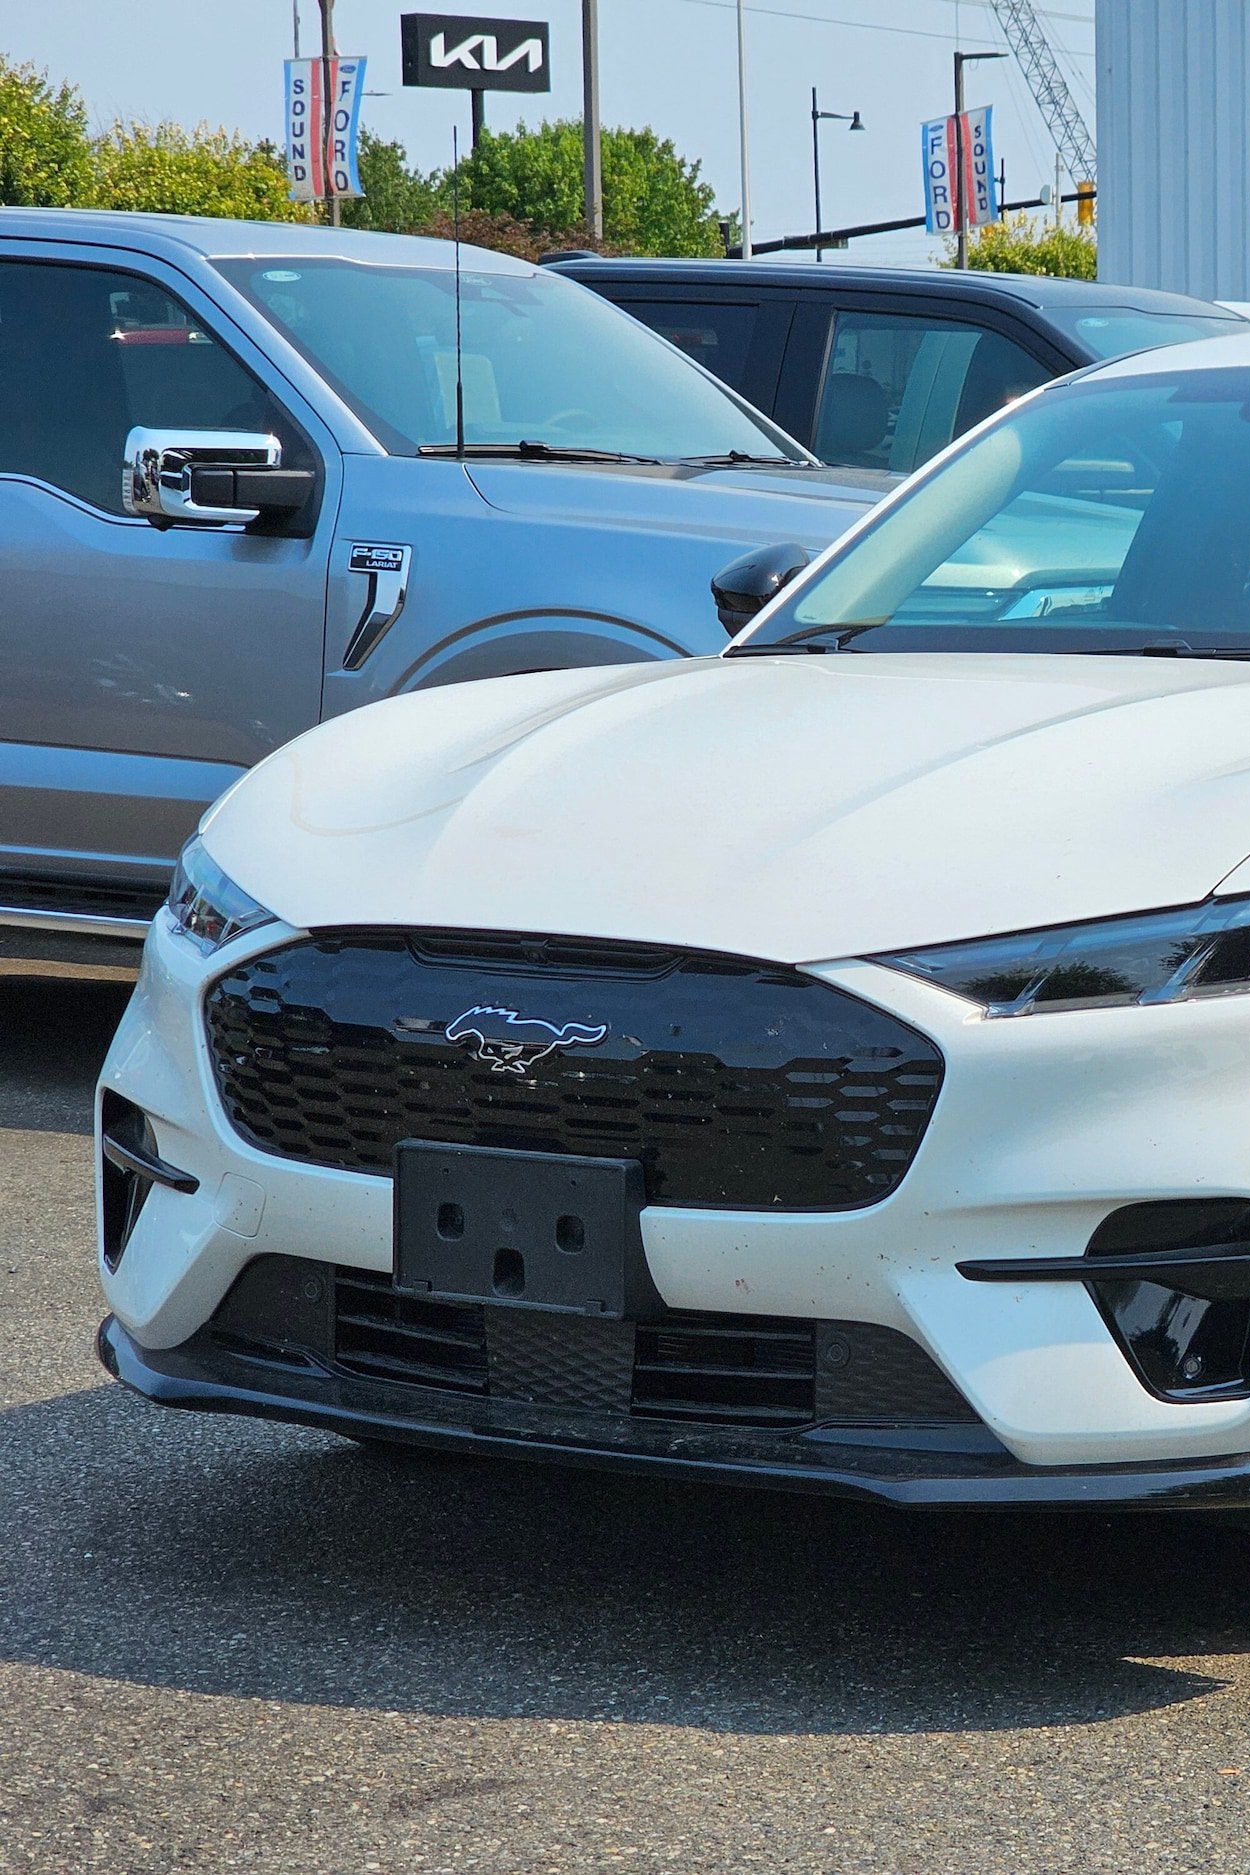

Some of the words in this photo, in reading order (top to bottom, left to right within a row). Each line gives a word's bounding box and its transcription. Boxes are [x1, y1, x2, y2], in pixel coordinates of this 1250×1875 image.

[430, 31, 543, 73] KIA
[292, 79, 306, 182] SOUND
[334, 80, 352, 191] FORD
[973, 125, 988, 211] SOUND
[929, 136, 950, 229] FORD
[353, 547, 403, 562] F-150
[366, 560, 398, 569] LARIAT
